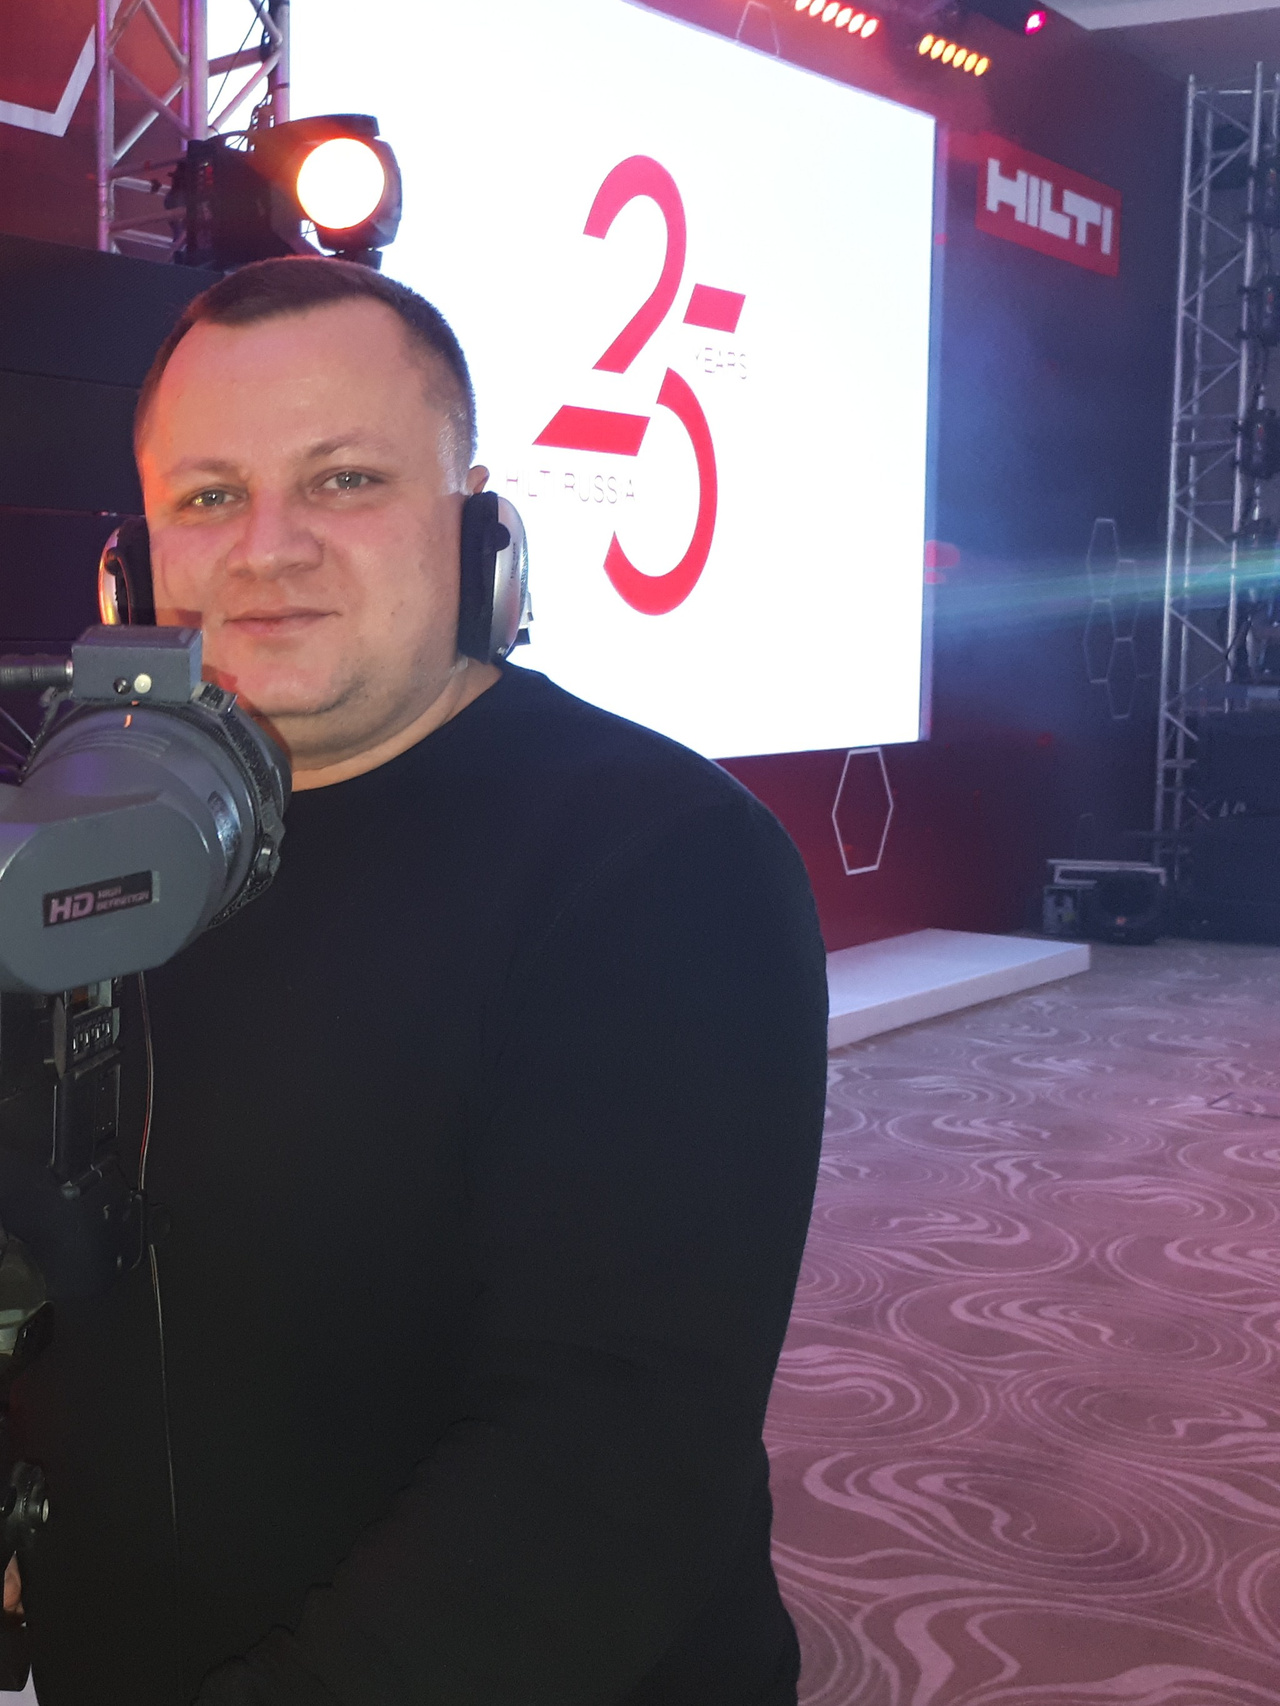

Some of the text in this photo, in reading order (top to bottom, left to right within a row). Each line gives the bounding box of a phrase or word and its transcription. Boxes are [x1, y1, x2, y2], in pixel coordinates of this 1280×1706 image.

[986, 157, 1113, 255] HILTI
[693, 345, 747, 380] EARS
[49, 892, 95, 923] HD
